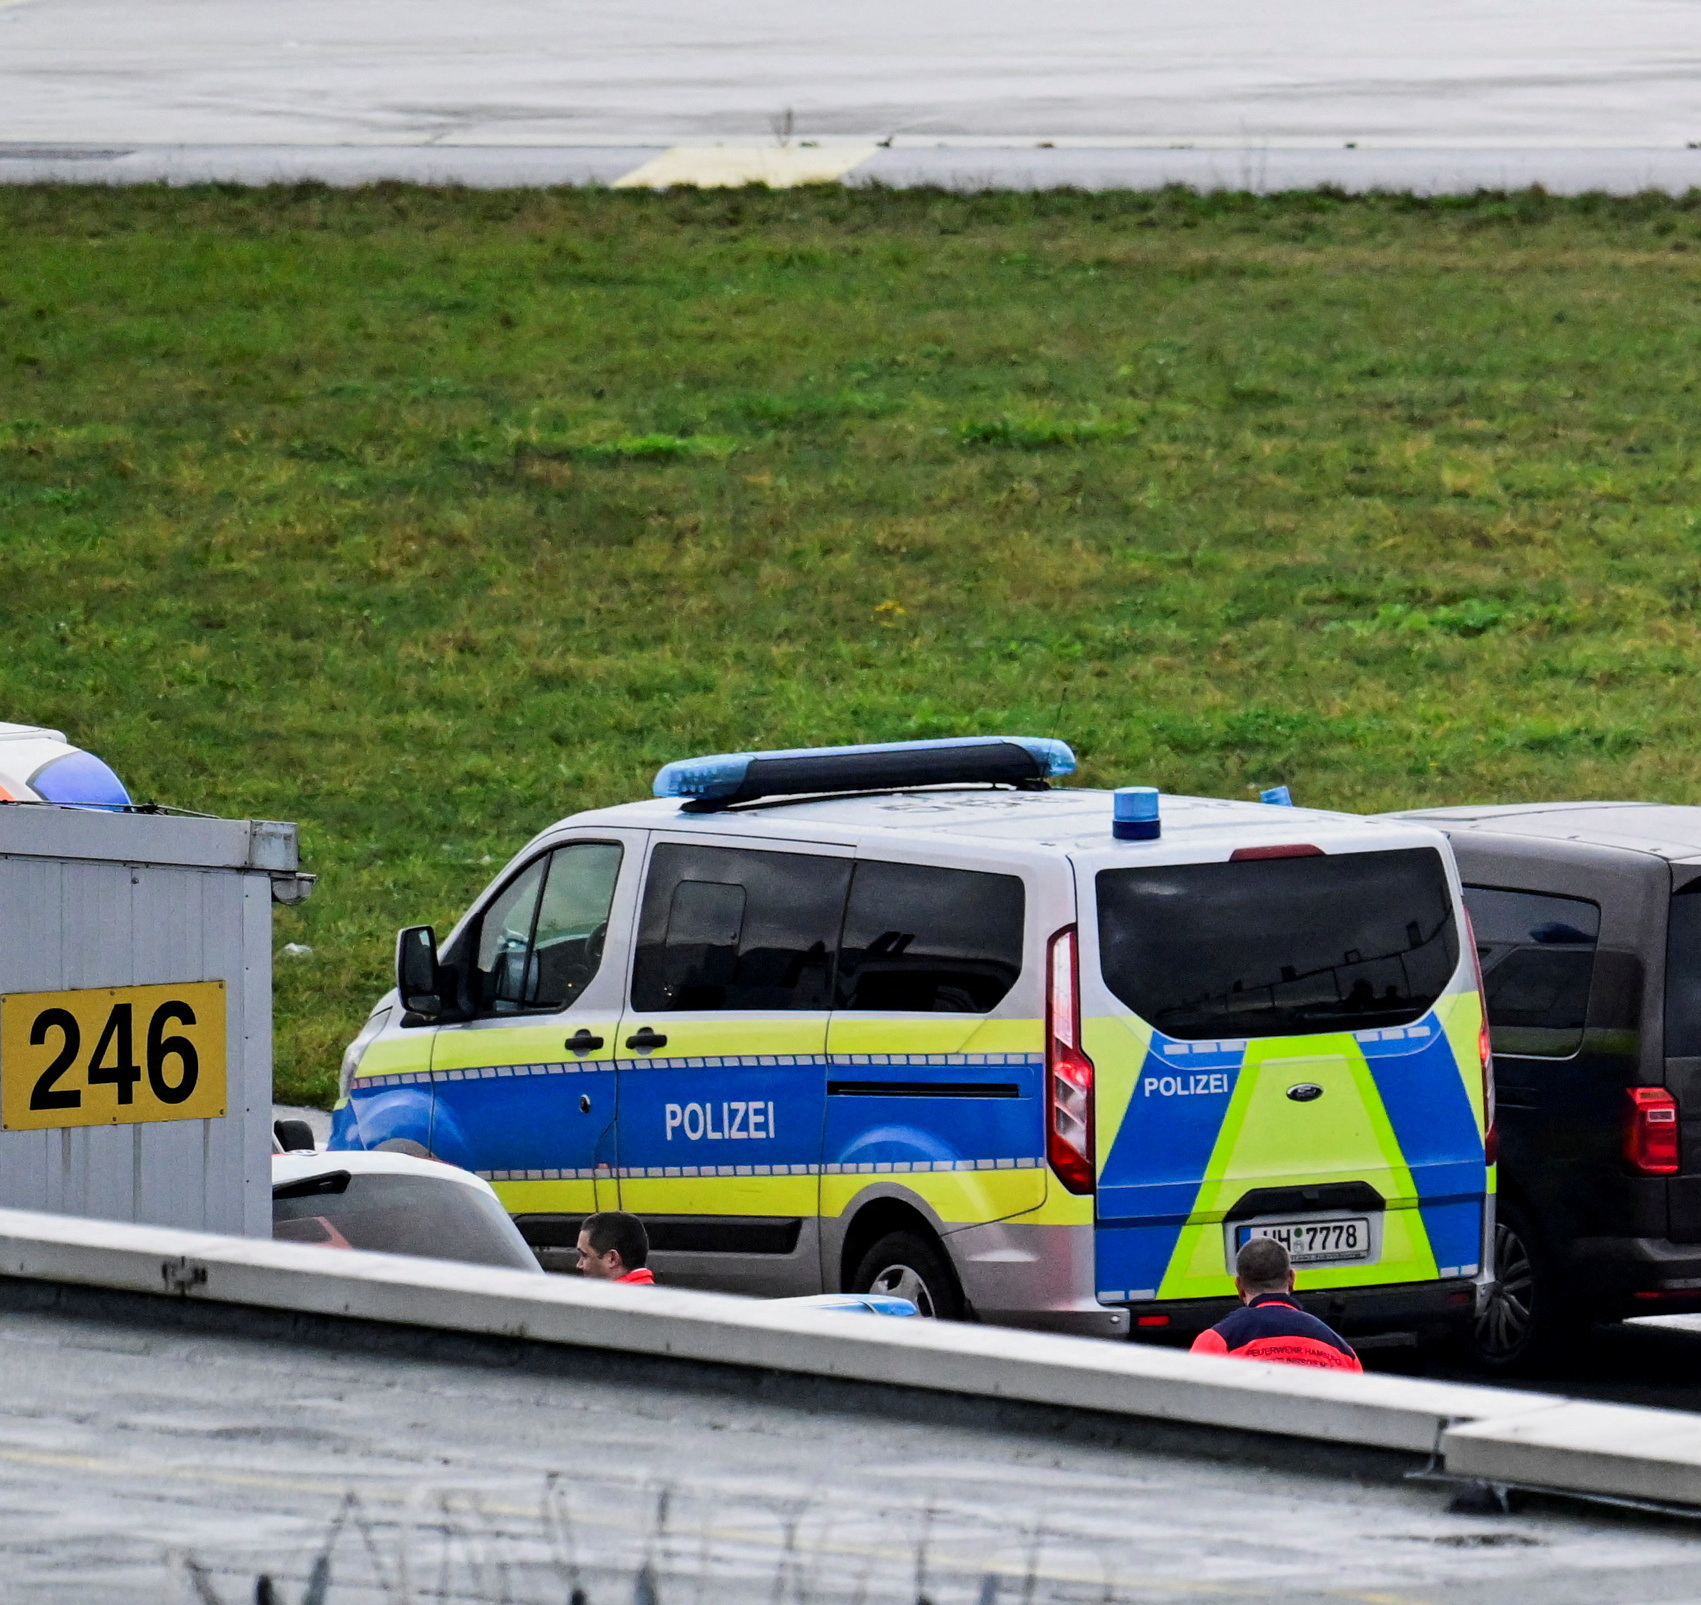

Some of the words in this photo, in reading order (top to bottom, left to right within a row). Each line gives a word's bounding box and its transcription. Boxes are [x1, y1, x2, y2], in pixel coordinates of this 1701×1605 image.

[29, 1000, 199, 1111] 246
[1144, 1074, 1229, 1097] POLIZEI
[665, 1101, 775, 1140] POLIZEI
[1306, 1224, 1357, 1251] 7778
